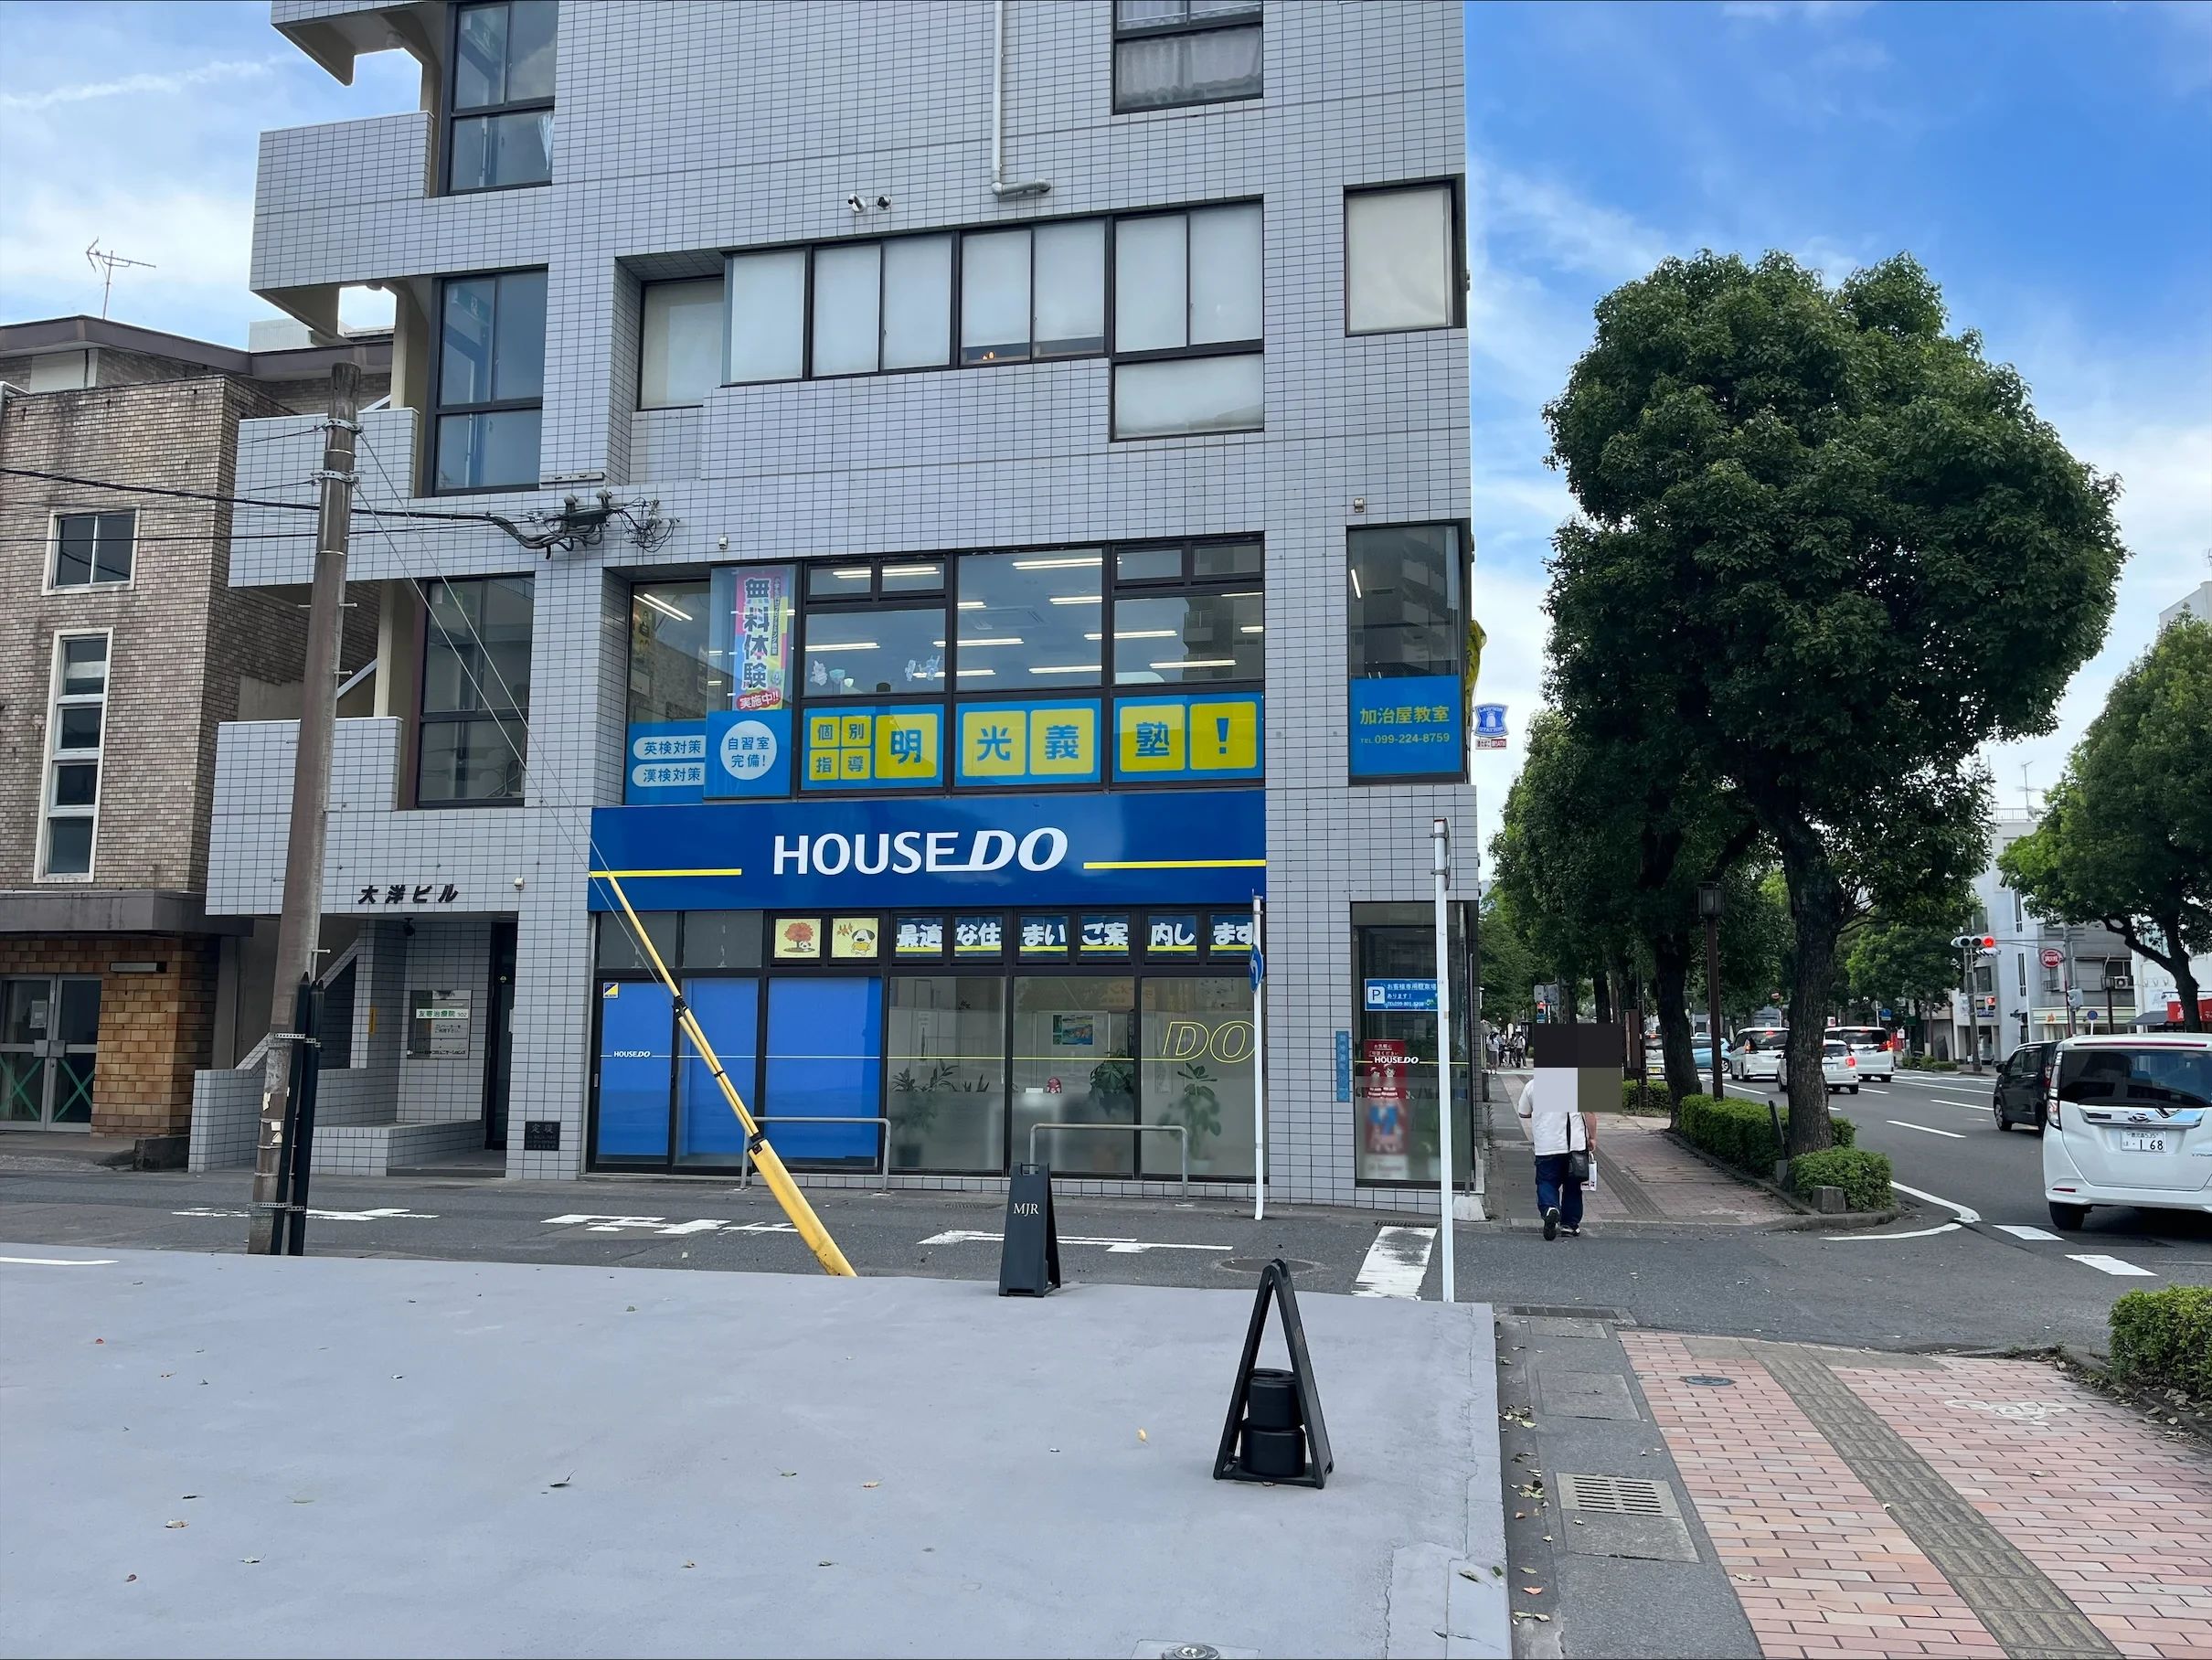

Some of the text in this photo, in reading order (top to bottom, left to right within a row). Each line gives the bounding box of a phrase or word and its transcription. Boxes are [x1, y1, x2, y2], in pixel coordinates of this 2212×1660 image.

[743, 578, 771, 689] 無料体験
[1359, 705, 1450, 725] 加治屋教室
[817, 723, 865, 741] 個別
[643, 740, 702, 756] 英検対策
[728, 737, 770, 751] 自習室
[731, 753, 766, 769] 完備!
[815, 755, 864, 773] 指導
[643, 767, 701, 782] 漢検対策
[357, 884, 458, 904] 大洋ビル
[1013, 1203, 1039, 1217] MJR
